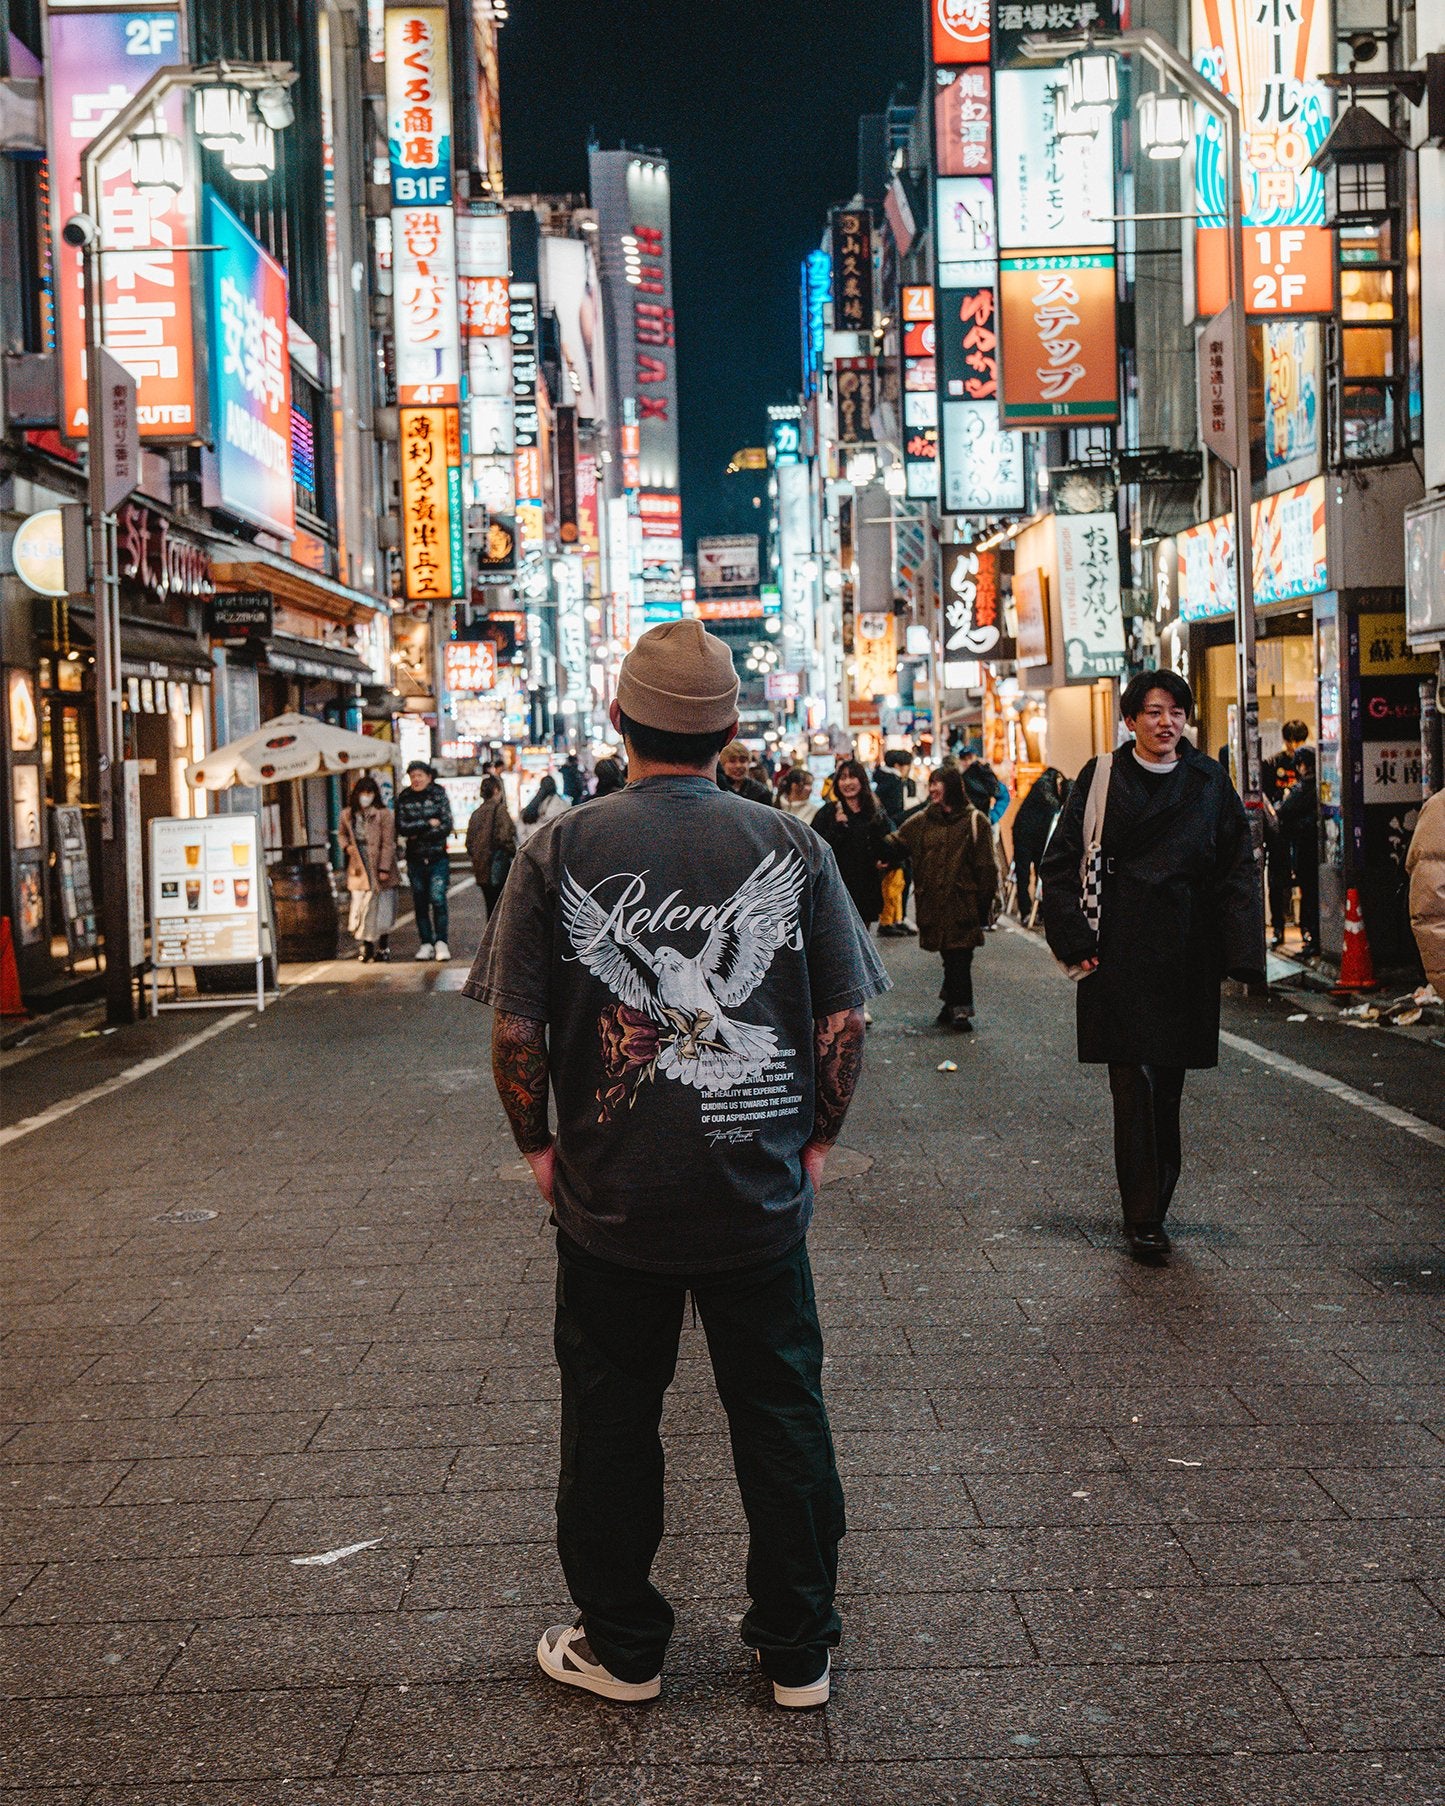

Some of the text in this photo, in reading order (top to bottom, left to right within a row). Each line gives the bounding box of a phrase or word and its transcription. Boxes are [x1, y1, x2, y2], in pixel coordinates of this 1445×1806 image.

[126, 19, 175, 55] 2F
[959, 74, 989, 169] 龍幻酒家
[1250, 133, 1304, 168] 50
[395, 177, 446, 200] B1F
[1259, 171, 1295, 209] 円
[1255, 231, 1306, 265] 1F
[1253, 275, 1306, 309] 2F
[1032, 273, 1087, 400] ステップ
[412, 385, 446, 404] 4F
[72, 404, 191, 427] AKUTEI
[1095, 656, 1126, 674] B1F
[562, 869, 804, 961] Relentless
[774, 1072, 794, 1082] SCULPT
[701, 1091, 714, 1099] THE
[714, 1089, 741, 1098] REALITY
[742, 1088, 752, 1097] WE
[701, 1095, 802, 1111] GUIDING US TOWARDS THE FRUITION
[701, 1115, 710, 1123] OF
[711, 1114, 726, 1122] OUR
[726, 1111, 767, 1122] ASPIRATIONS
[767, 1110, 778, 1118] AND
